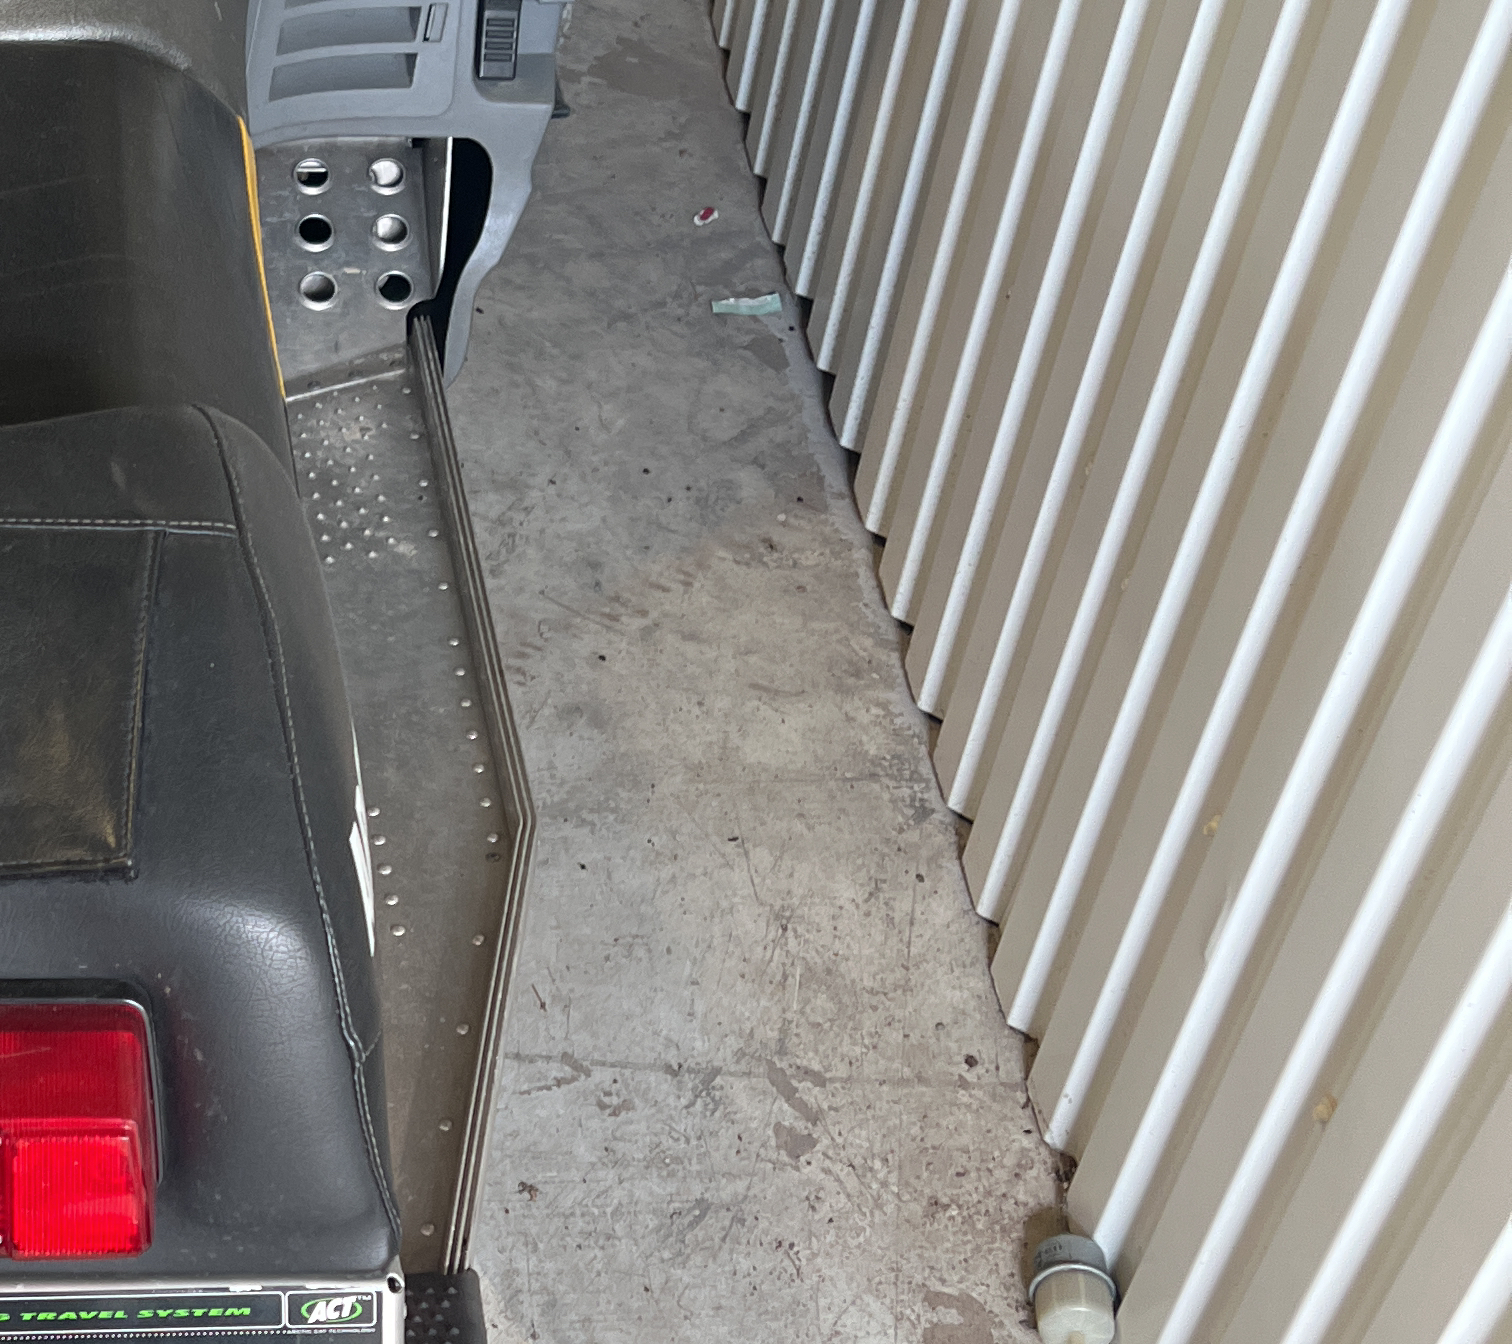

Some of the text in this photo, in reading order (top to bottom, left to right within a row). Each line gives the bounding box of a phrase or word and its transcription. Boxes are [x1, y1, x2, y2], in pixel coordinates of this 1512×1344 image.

[19, 1308, 129, 1322] TRAVEL
[135, 1306, 252, 1320] SYSTEM
[307, 1295, 357, 1324] ACT
